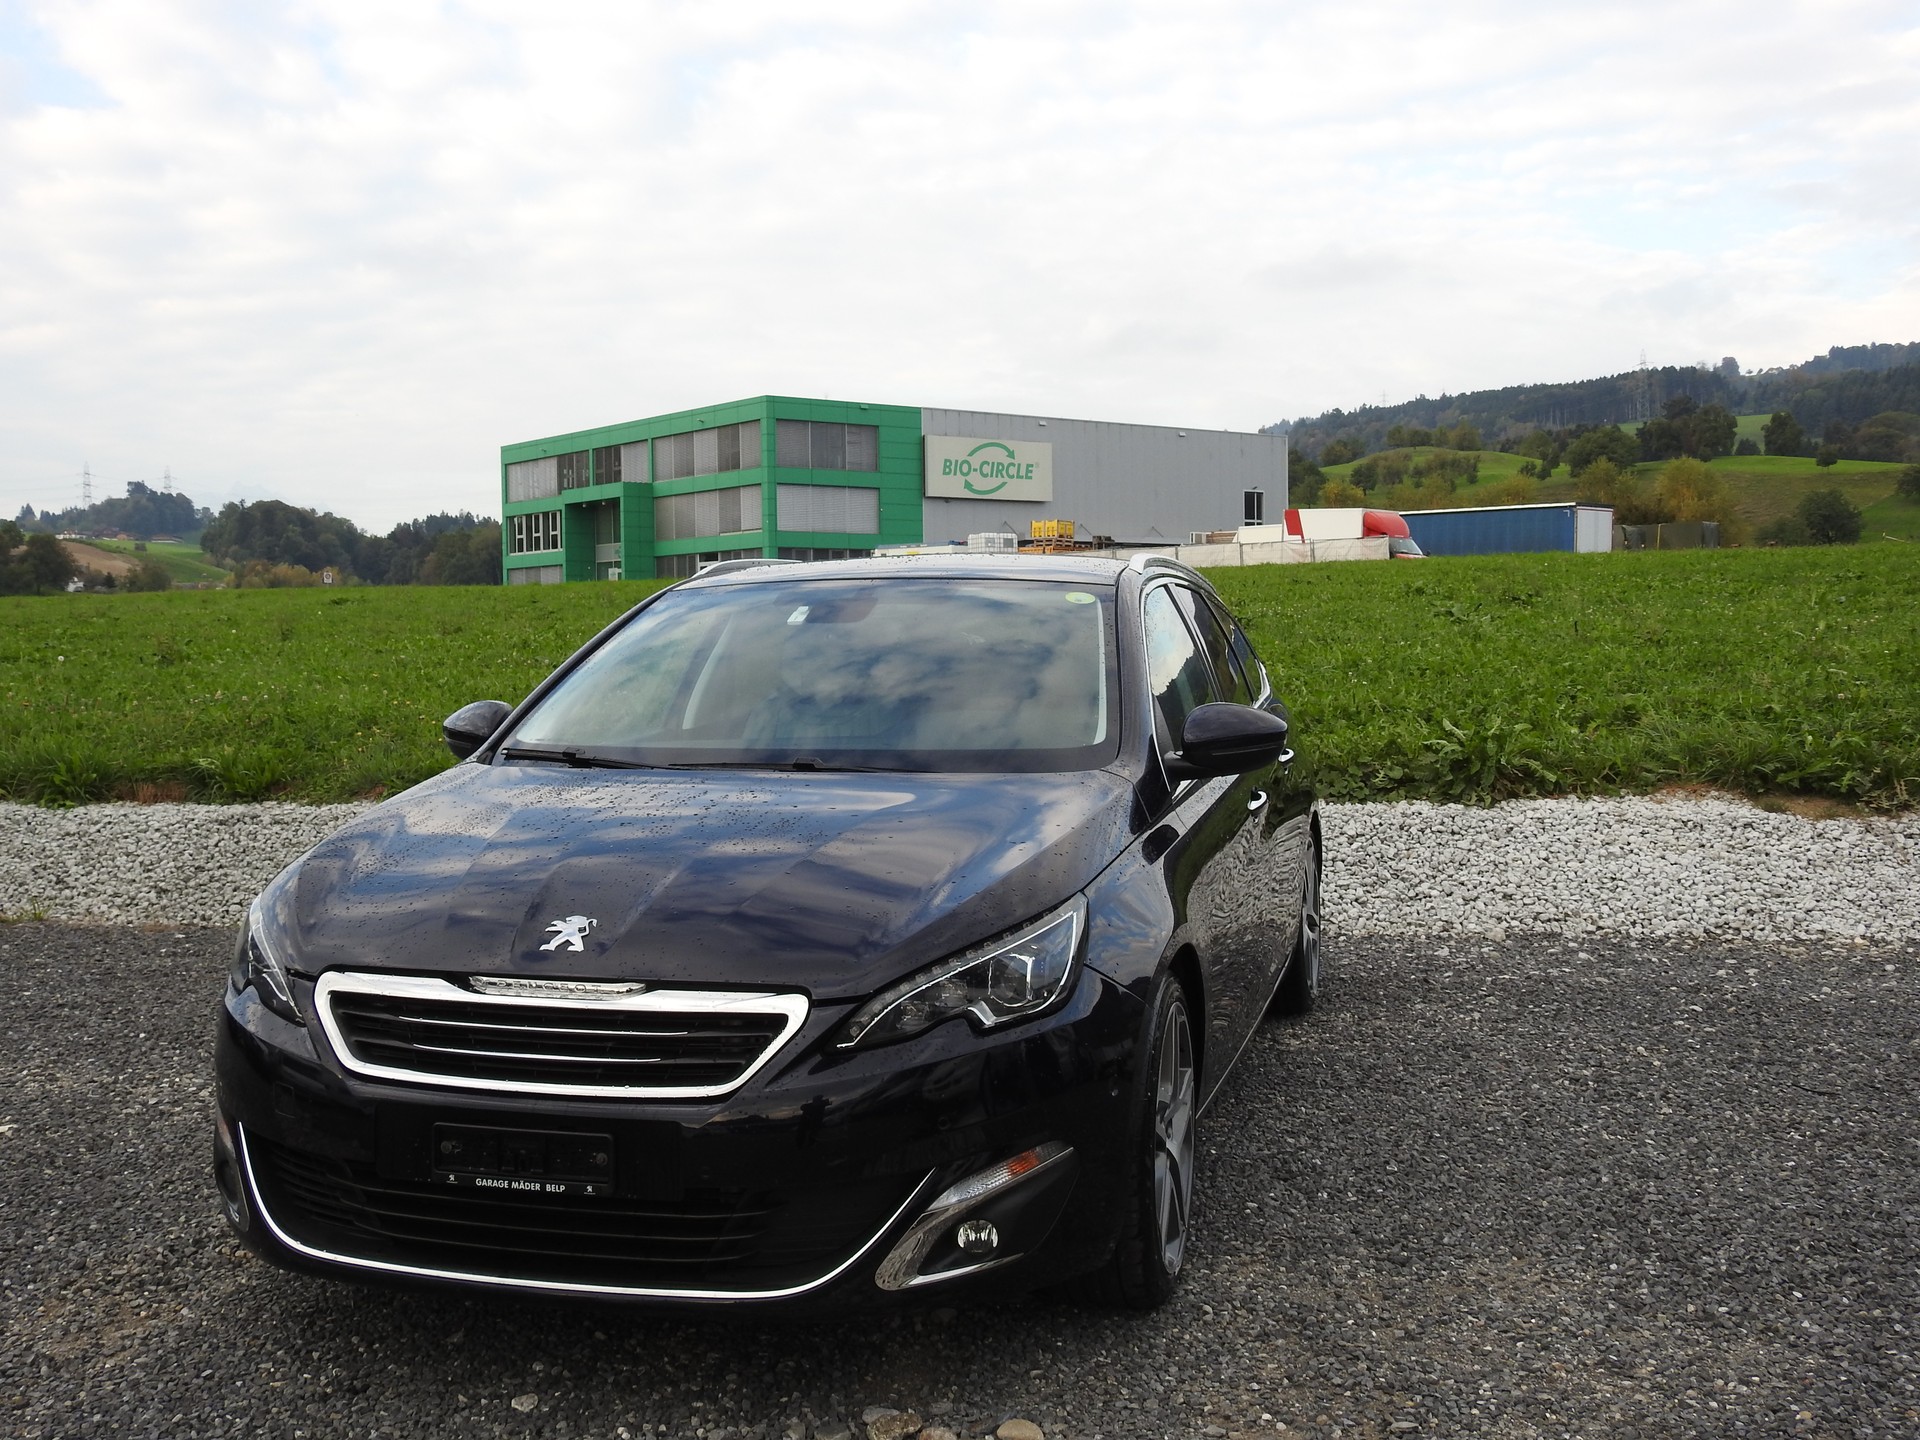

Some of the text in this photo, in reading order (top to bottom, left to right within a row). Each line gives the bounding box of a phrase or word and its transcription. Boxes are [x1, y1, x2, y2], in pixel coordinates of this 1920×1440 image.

[942, 458, 1034, 480] BIO-CIRCLE
[475, 1178, 509, 1189] GARAGE
[545, 1183, 566, 1193] BELP
